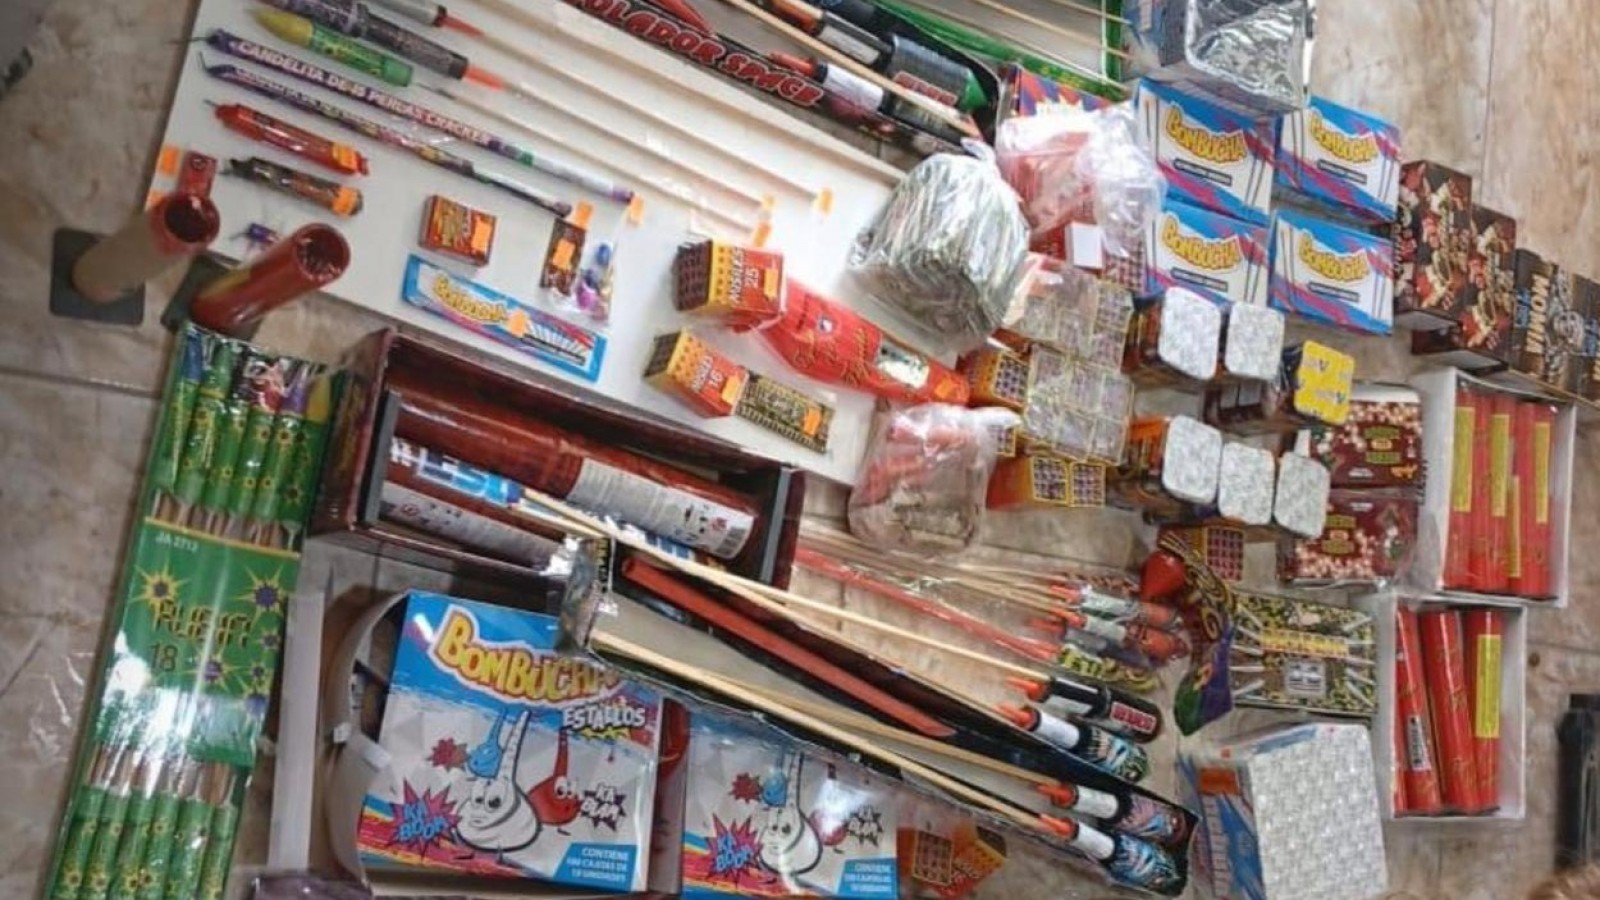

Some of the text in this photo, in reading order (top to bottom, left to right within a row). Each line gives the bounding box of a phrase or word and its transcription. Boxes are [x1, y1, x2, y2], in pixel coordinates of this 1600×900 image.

[240, 40, 325, 82] CANDELITA
[568, 0, 726, 66] OLADOR
[721, 52, 824, 106] SPACE
[150, 643, 179, 673] 18
[563, 703, 646, 731] ESTALLOS
